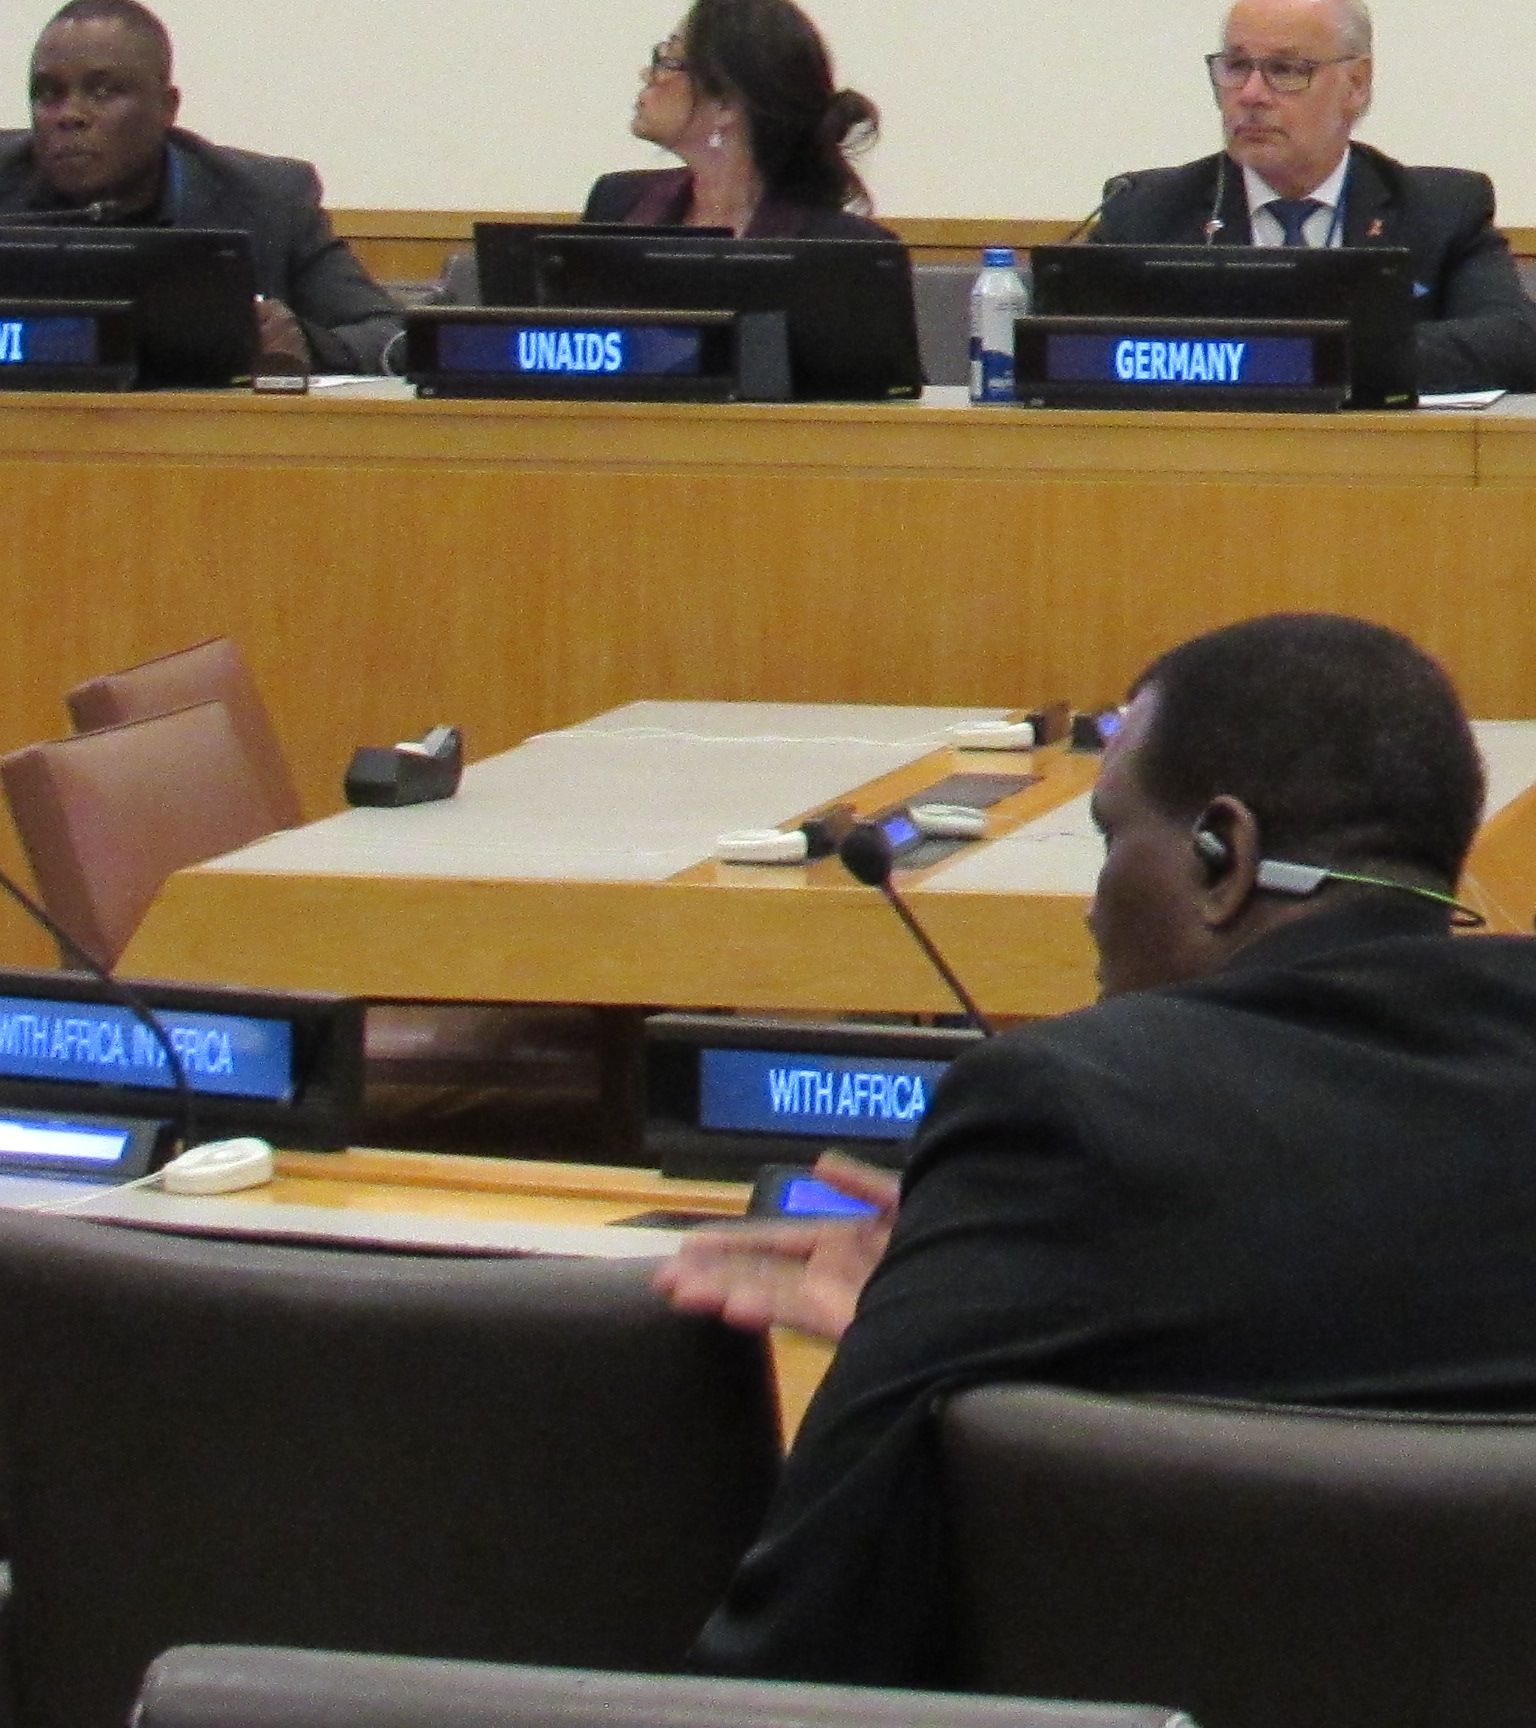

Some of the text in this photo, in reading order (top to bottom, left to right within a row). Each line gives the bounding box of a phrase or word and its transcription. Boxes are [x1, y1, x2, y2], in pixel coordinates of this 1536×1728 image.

[518, 331, 622, 371] UNAIDS
[1115, 339, 1244, 381] GERMANY
[769, 1069, 833, 1114] WITH
